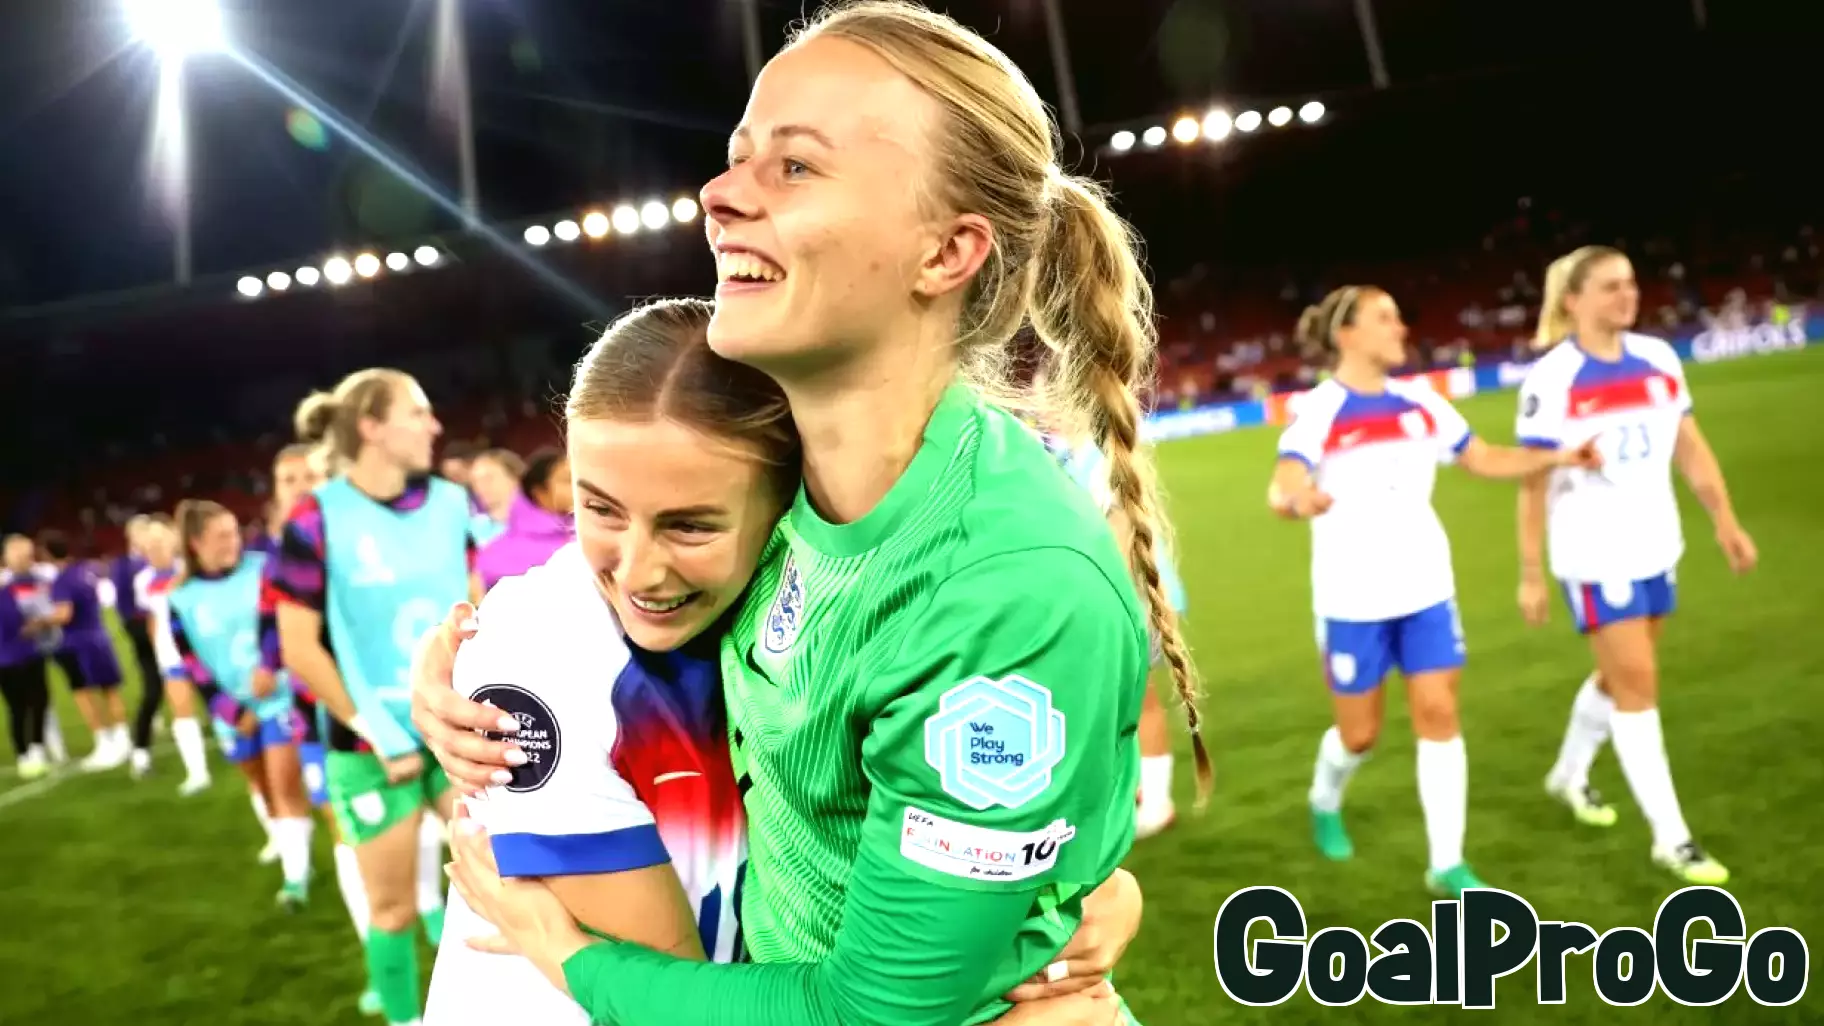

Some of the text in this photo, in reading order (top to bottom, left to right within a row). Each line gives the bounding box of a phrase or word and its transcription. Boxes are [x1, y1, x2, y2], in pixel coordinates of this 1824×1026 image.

[1616, 422, 1652, 463] 23
[970, 722, 994, 735] We
[971, 737, 1005, 752] Play
[971, 752, 1023, 766] Strong
[908, 812, 934, 827] UEFA
